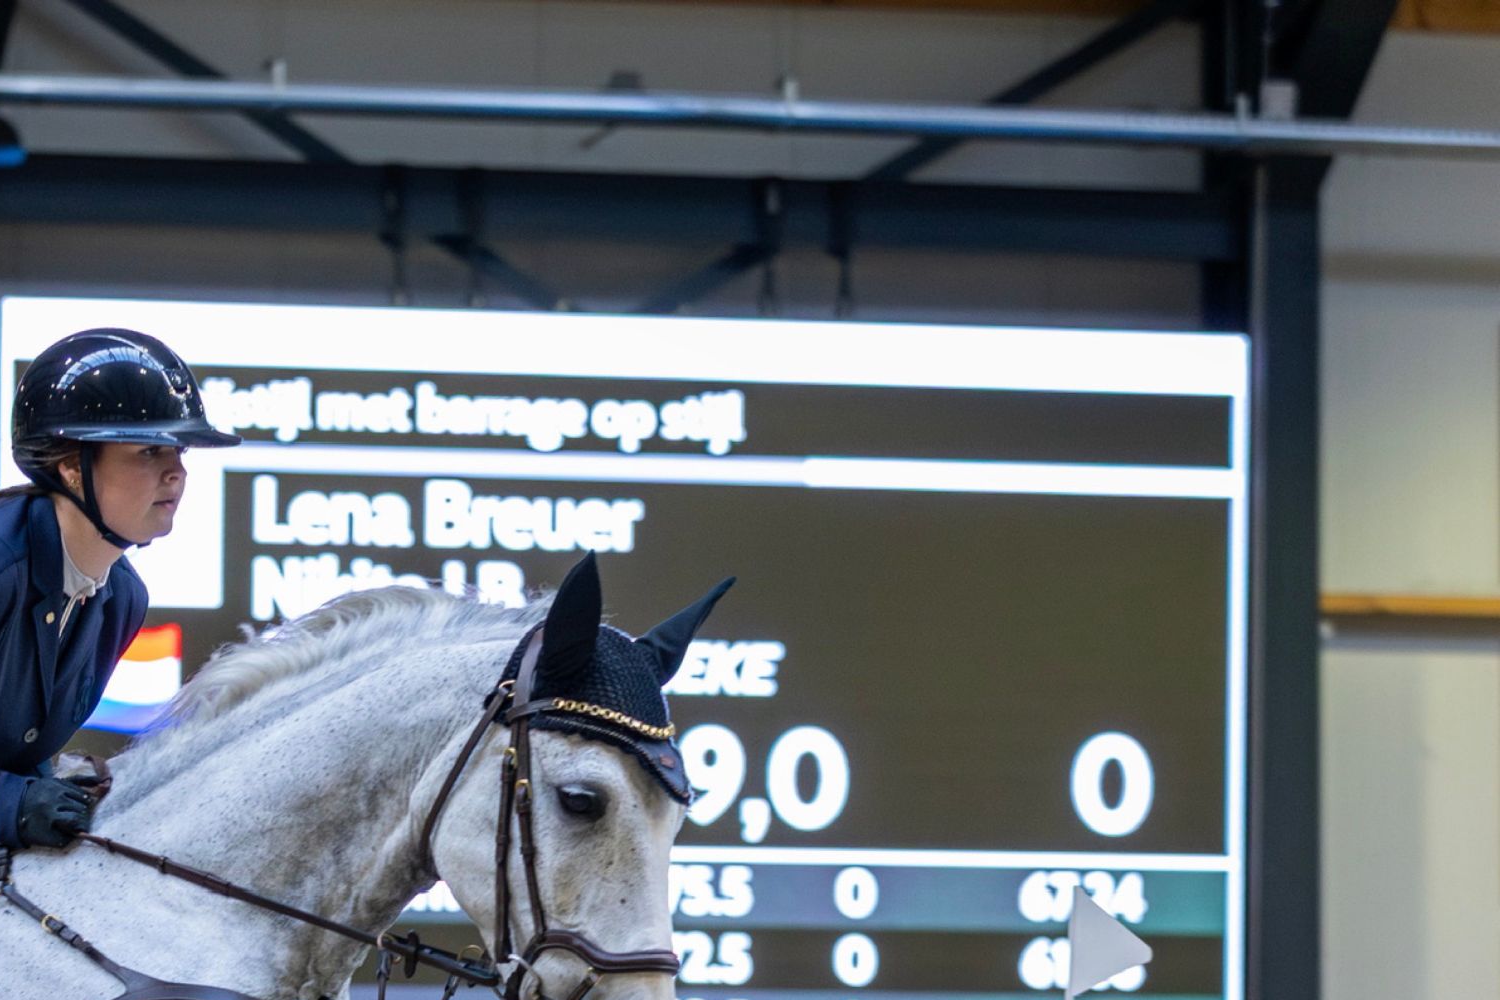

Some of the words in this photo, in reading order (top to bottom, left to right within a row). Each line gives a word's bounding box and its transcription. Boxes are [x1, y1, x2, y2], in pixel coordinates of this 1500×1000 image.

[252, 474, 415, 548] Lena
[423, 478, 646, 553] Breuer
[1071, 730, 1155, 838] 0
[833, 866, 879, 919] 0
[832, 932, 879, 987] 0
